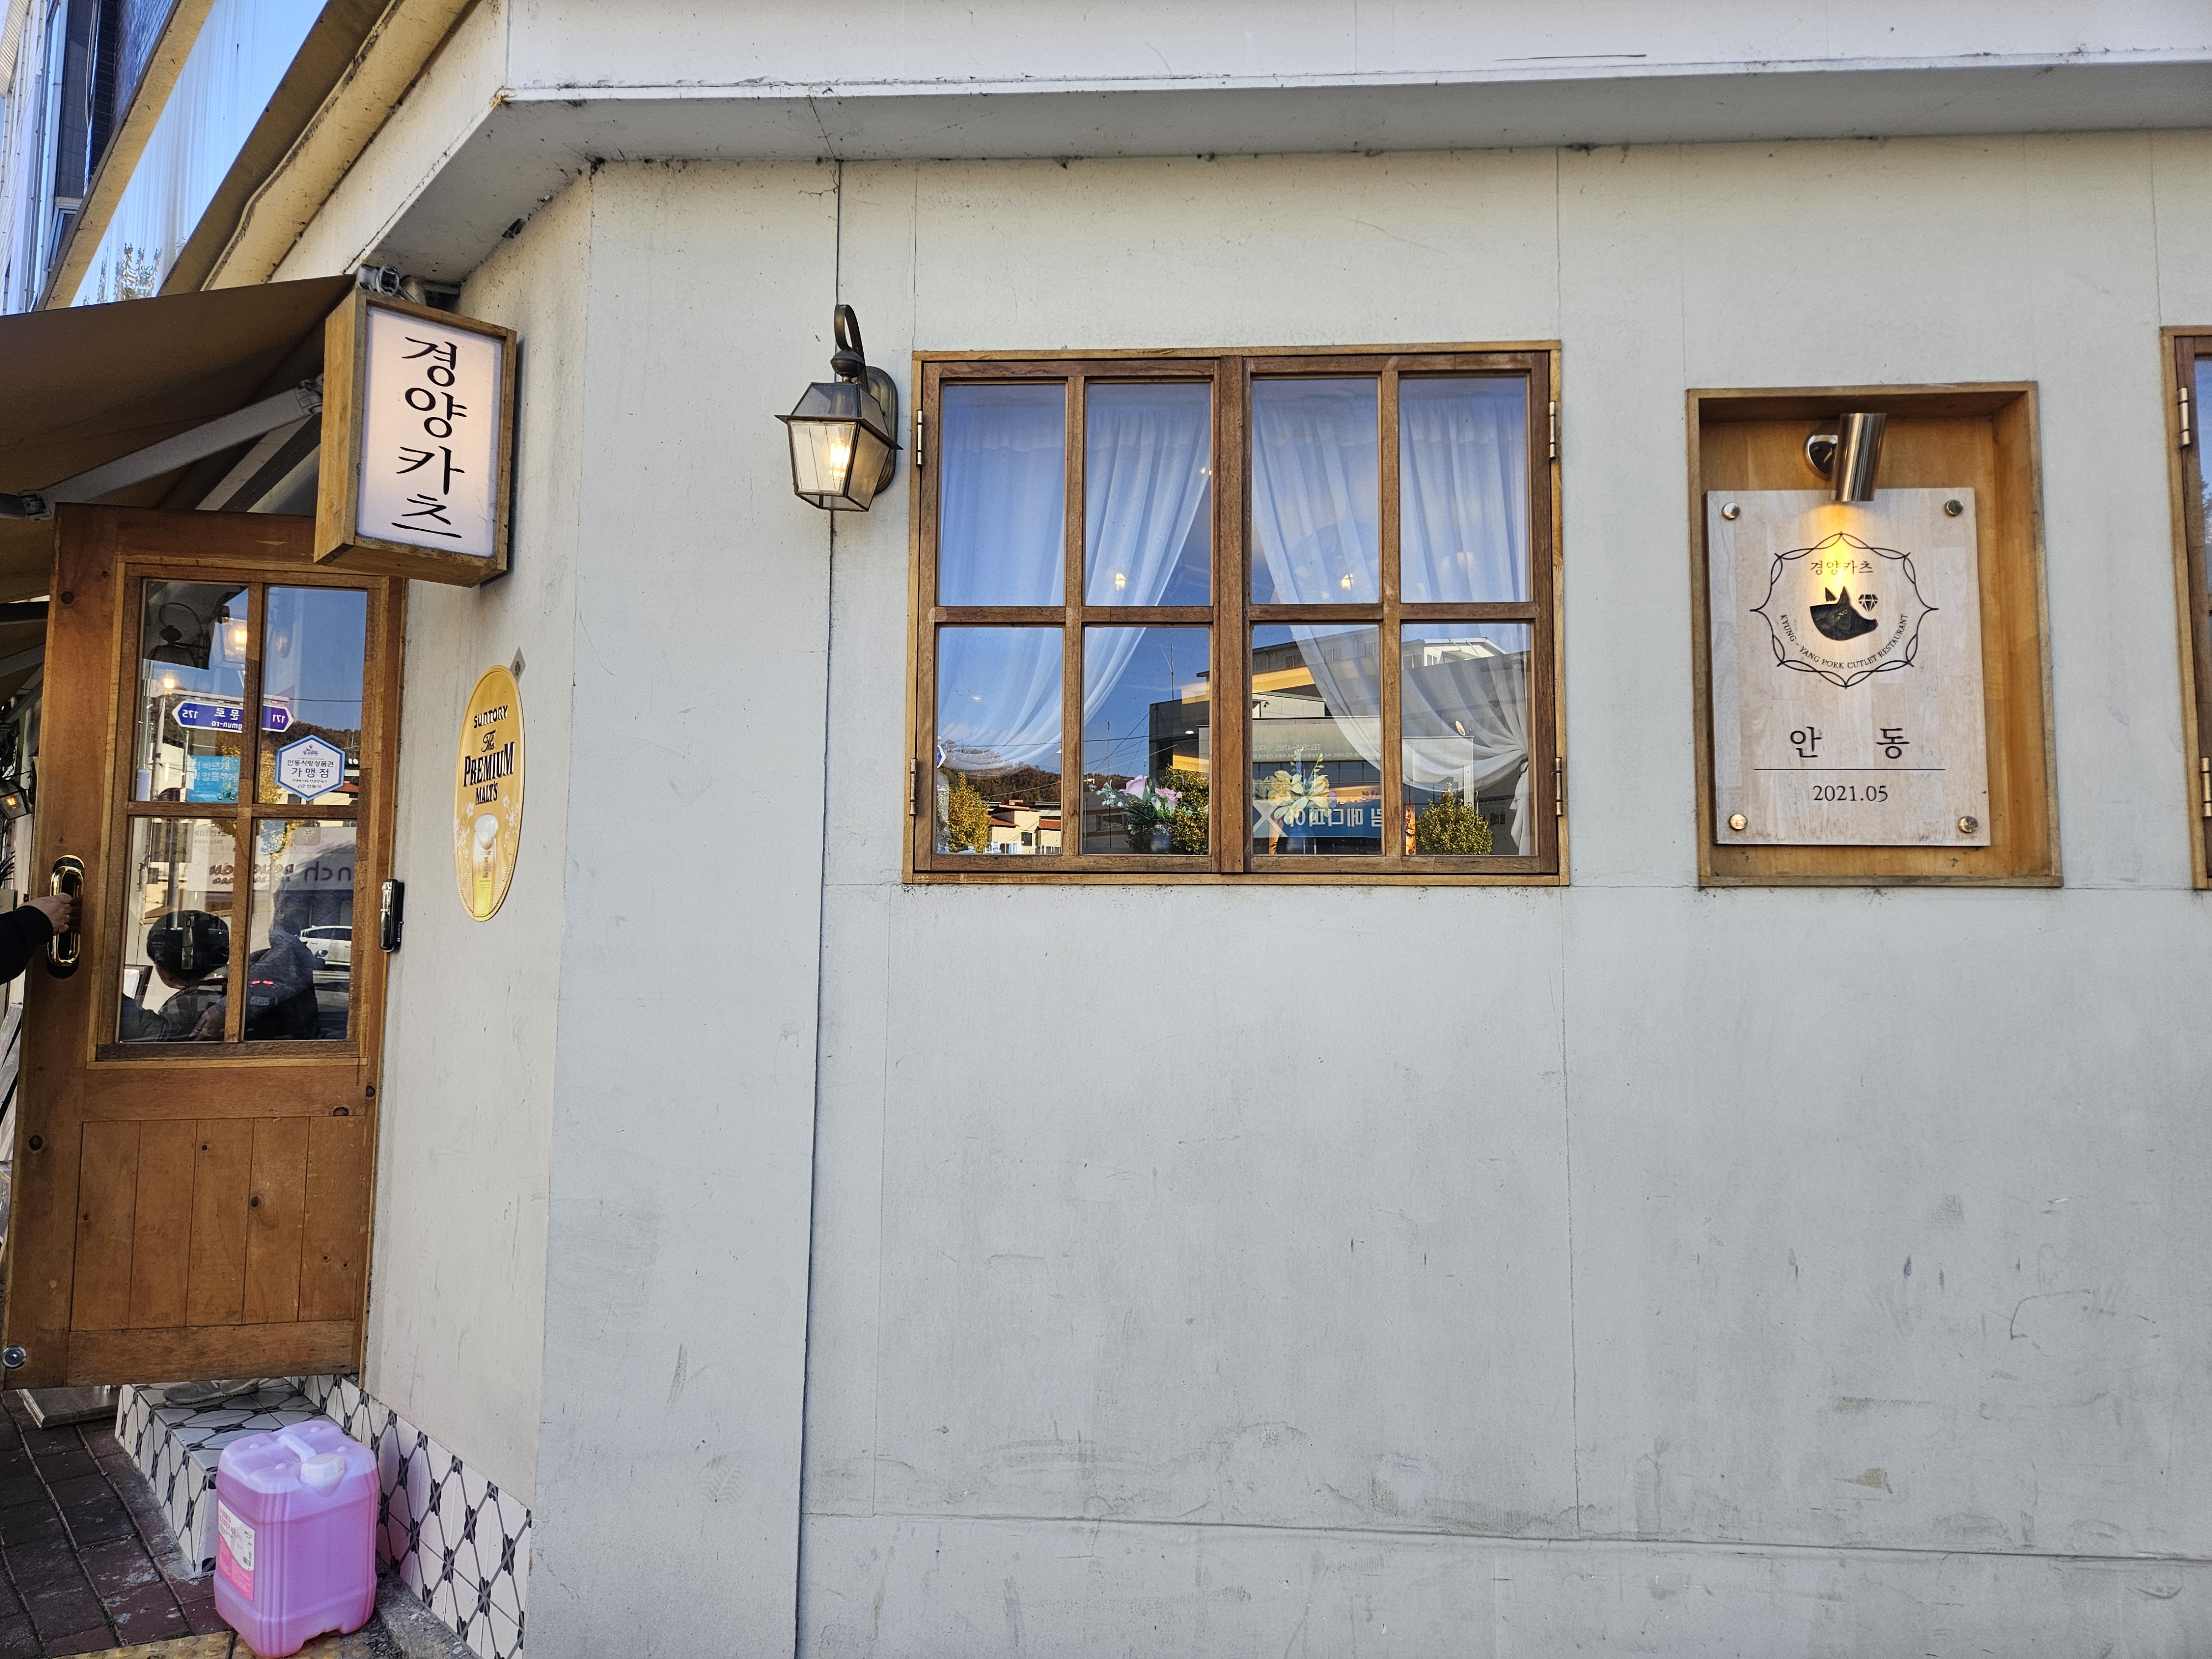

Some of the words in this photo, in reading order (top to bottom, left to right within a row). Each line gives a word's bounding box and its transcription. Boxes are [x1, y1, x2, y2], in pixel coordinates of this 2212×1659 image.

[391, 336, 467, 538] 경양카츠
[1810, 560, 1874, 575] 경양카츠
[1780, 614, 1797, 642] KYUNG
[1799, 646, 1819, 662] YANG
[1822, 659, 1844, 669] PORK
[1847, 655, 1877, 669] CUTLET
[1879, 613, 1908, 658] RESTAURANT
[473, 705, 508, 729] SUNTORY
[481, 729, 497, 753] The
[291, 768, 329, 778] 가맹점
[463, 742, 515, 787] PREMIUM
[475, 780, 498, 805] MALT'S
[1813, 785, 1888, 802] 2021.05
